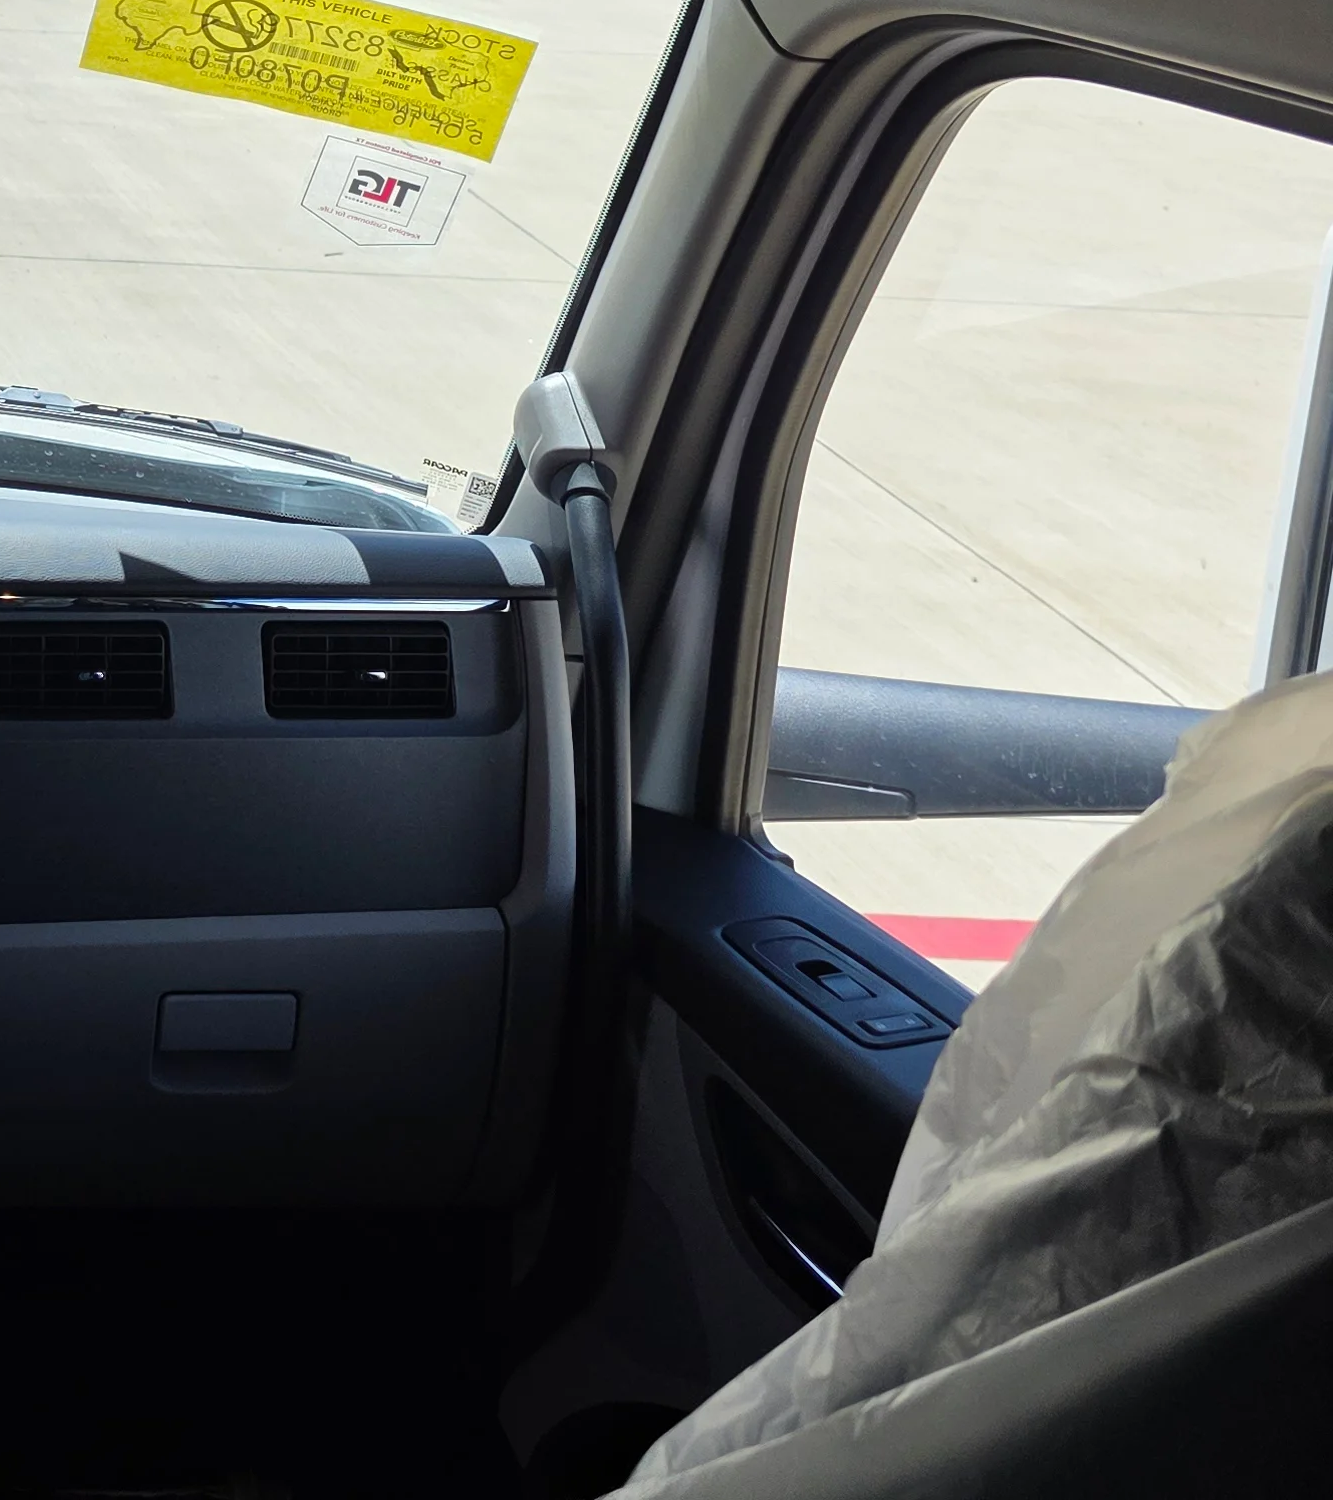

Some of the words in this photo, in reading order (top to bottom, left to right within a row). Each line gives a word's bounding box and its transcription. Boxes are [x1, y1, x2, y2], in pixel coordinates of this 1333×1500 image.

[322, 1, 393, 24] VEHICLE
[383, 79, 411, 91] PRIDE
[398, 74, 423, 85] WITH
